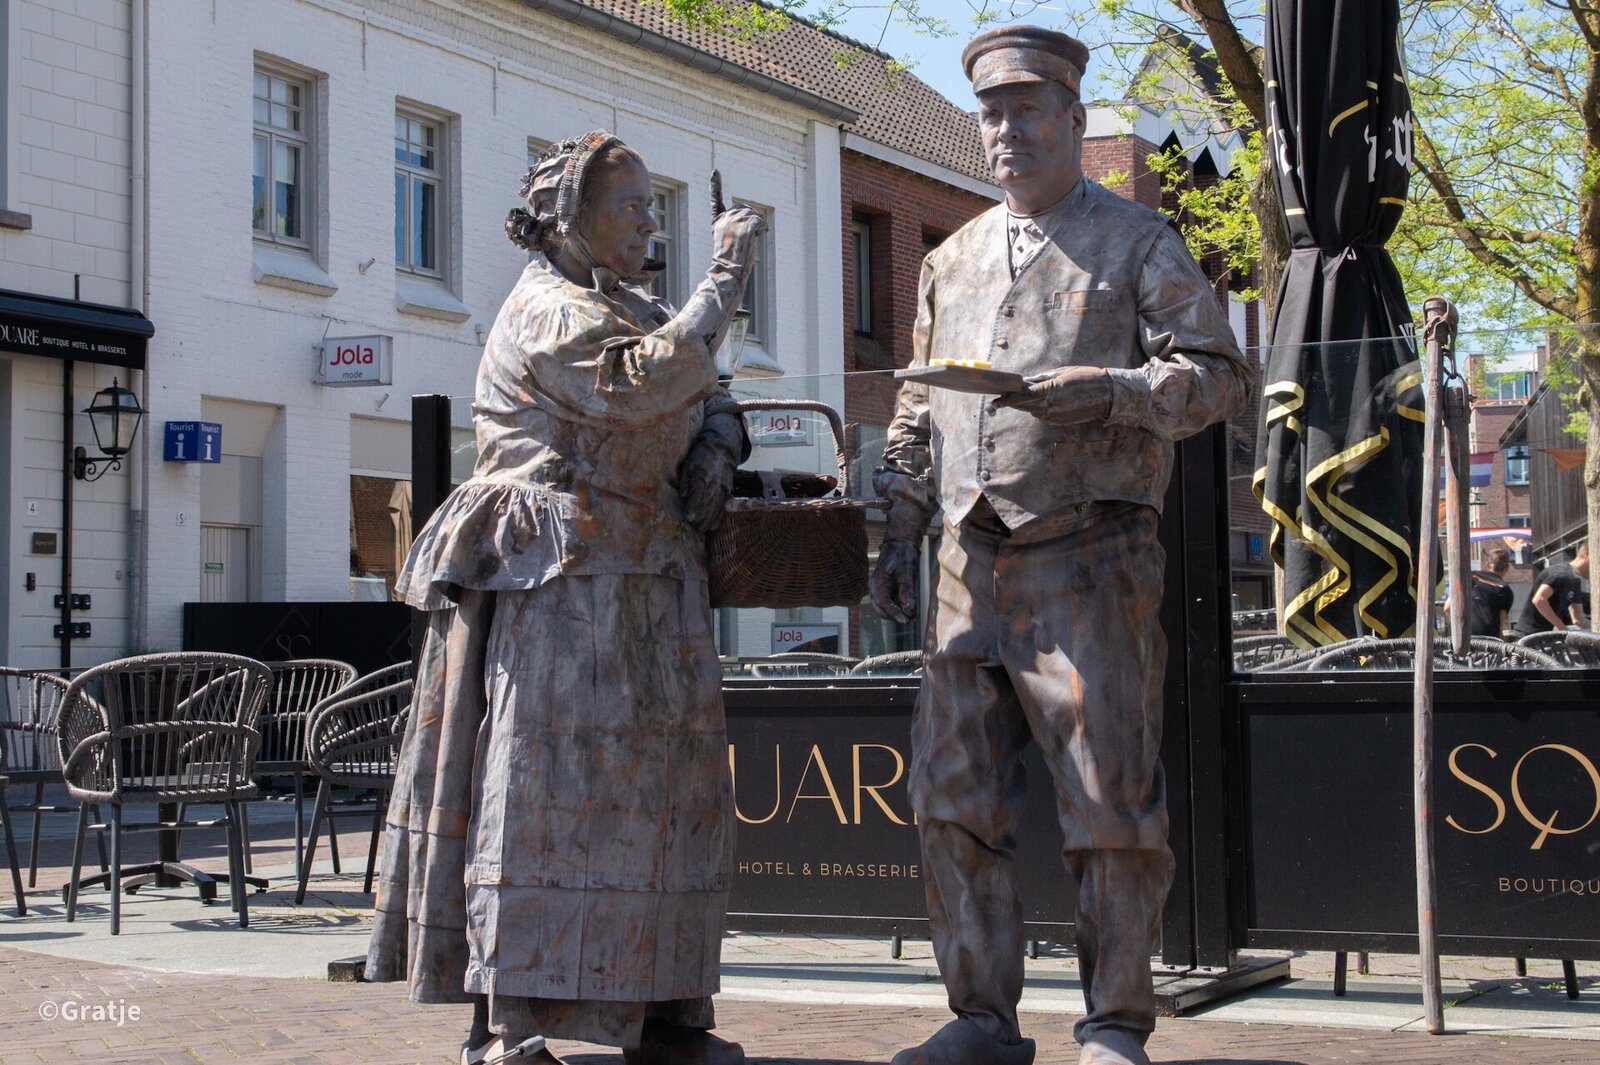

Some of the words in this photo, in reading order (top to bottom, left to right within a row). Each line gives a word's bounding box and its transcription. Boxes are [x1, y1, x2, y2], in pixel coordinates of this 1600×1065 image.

[42, 337, 70, 348] BOUTIQUE
[72, 341, 88, 350] HOTEL
[97, 345, 127, 355] BRASSERIE
[330, 344, 373, 366] Jola
[342, 370, 363, 379] mode
[169, 423, 194, 431] Tourist
[201, 424, 219, 433] Tourist
[30, 504, 35, 513] 4
[776, 630, 803, 642] Jola
[728, 744, 918, 825] UAR
[739, 862, 795, 875] HOTEL
[802, 863, 812, 875] &
[820, 863, 919, 878] BRASSERIE
